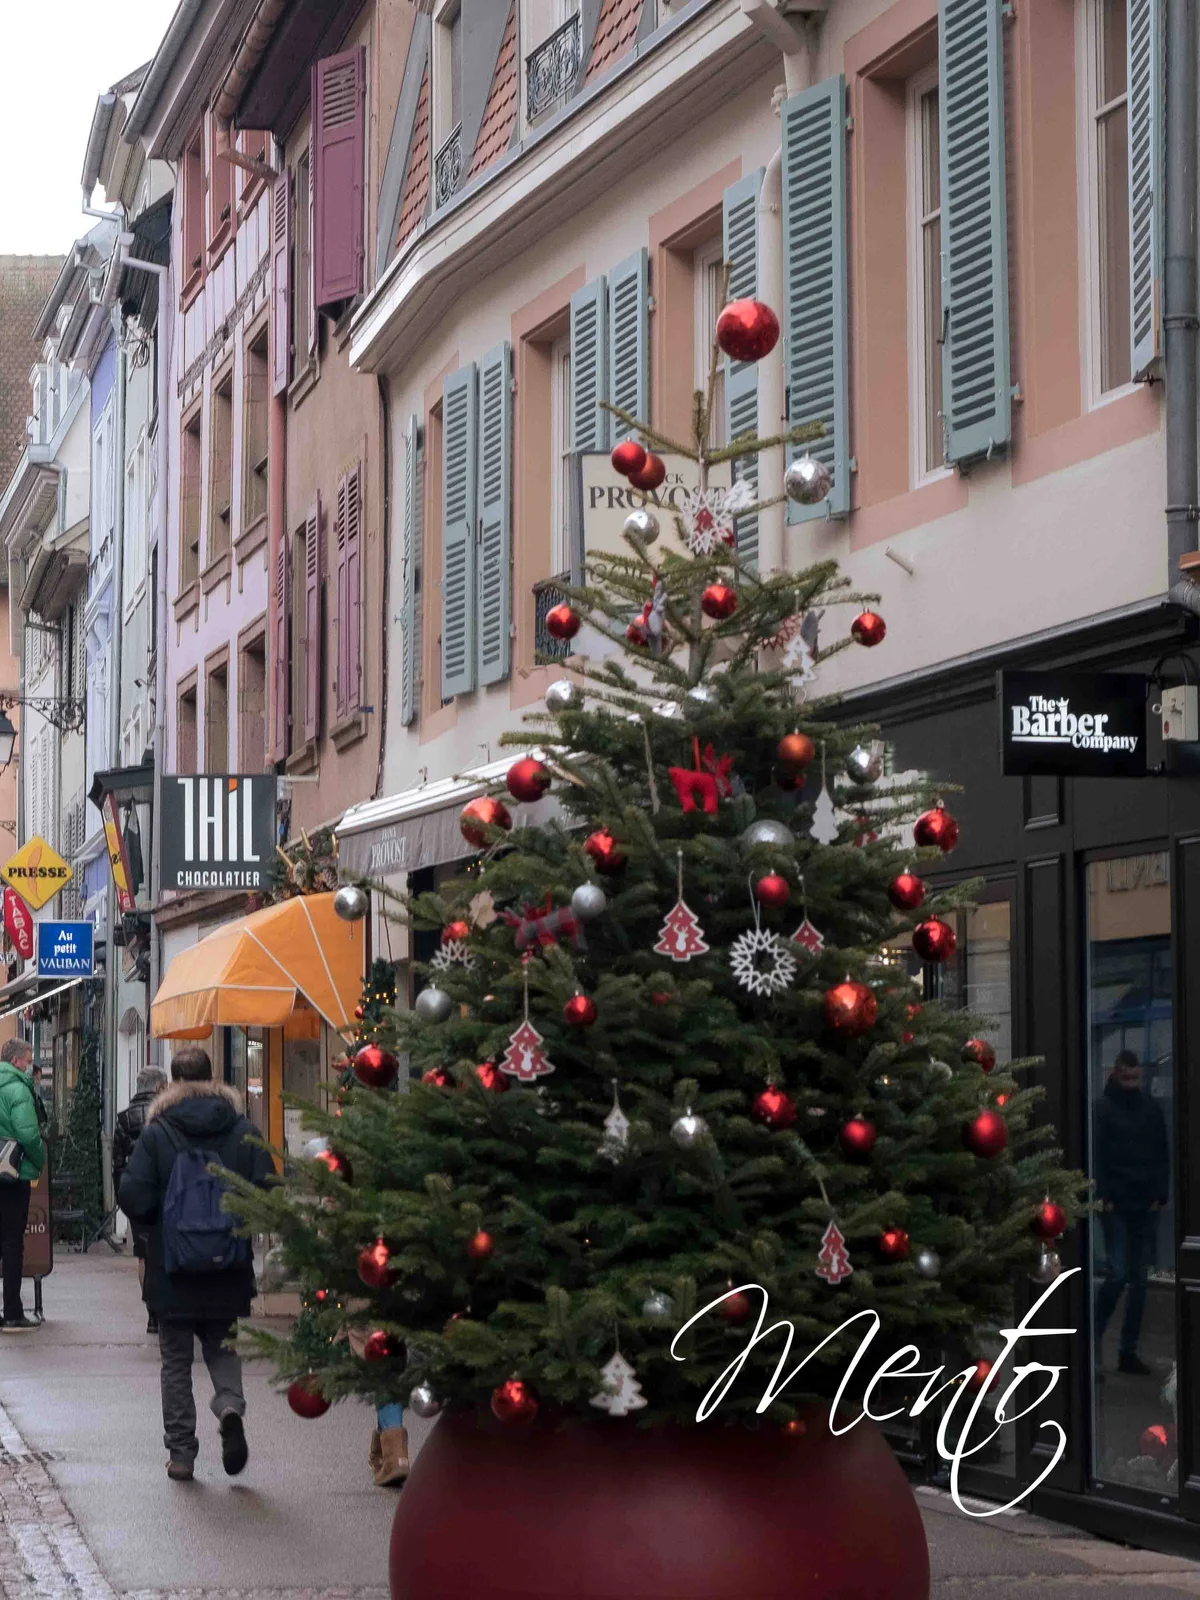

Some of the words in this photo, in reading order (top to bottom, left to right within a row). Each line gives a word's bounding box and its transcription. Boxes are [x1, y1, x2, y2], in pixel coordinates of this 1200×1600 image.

[1029, 695, 1056, 712] The
[1011, 703, 1109, 737] Barber
[1071, 732, 1139, 753] Company
[8, 866, 67, 878] PRESSE
[177, 870, 260, 887] CHOCOLATIER
[8, 895, 29, 950] TABAC
[57, 930, 73, 941] Au
[53, 943, 77, 957] petit
[40, 958, 91, 969] VAUBAN
